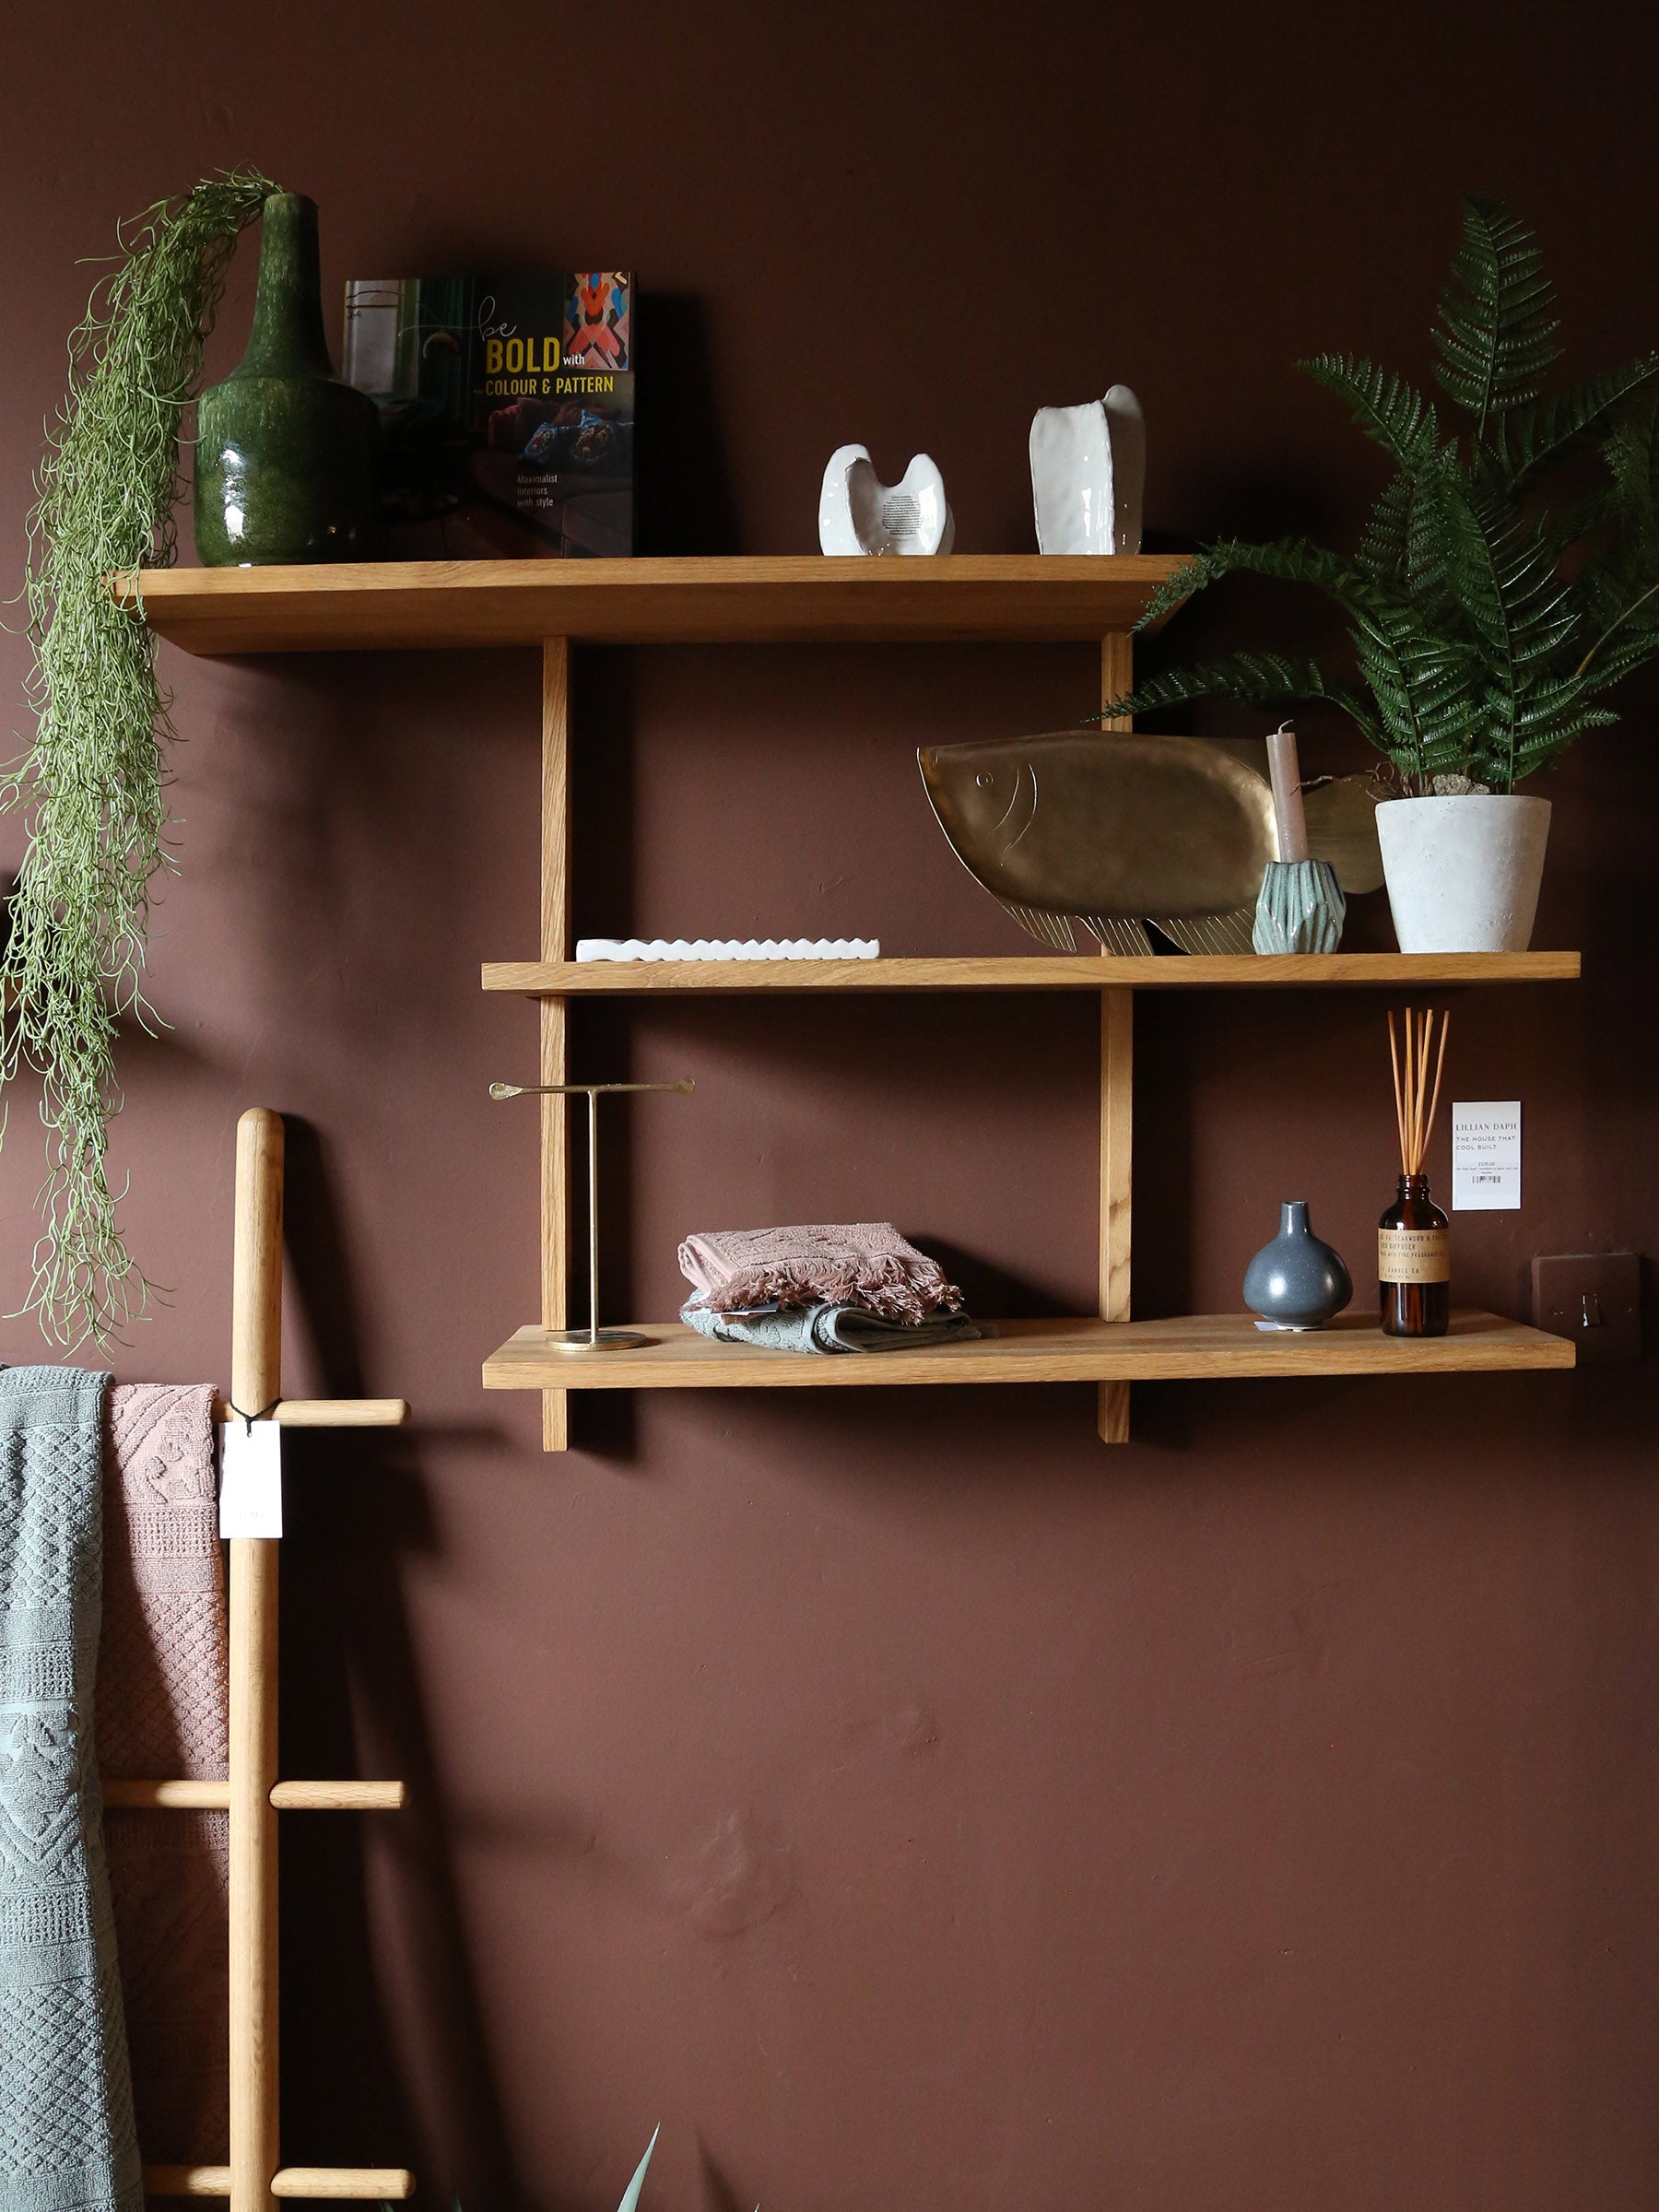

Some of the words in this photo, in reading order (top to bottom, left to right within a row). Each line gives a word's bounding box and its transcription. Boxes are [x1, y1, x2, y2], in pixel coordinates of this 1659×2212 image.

[486, 336, 560, 374] BOLD
[562, 354, 585, 366] with
[485, 379, 537, 396] COLOUR
[542, 379, 551, 394] &
[556, 376, 614, 394] PATTERN
[517, 474, 558, 484] Maximalist
[517, 498, 534, 507] with
[535, 497, 554, 509] style
